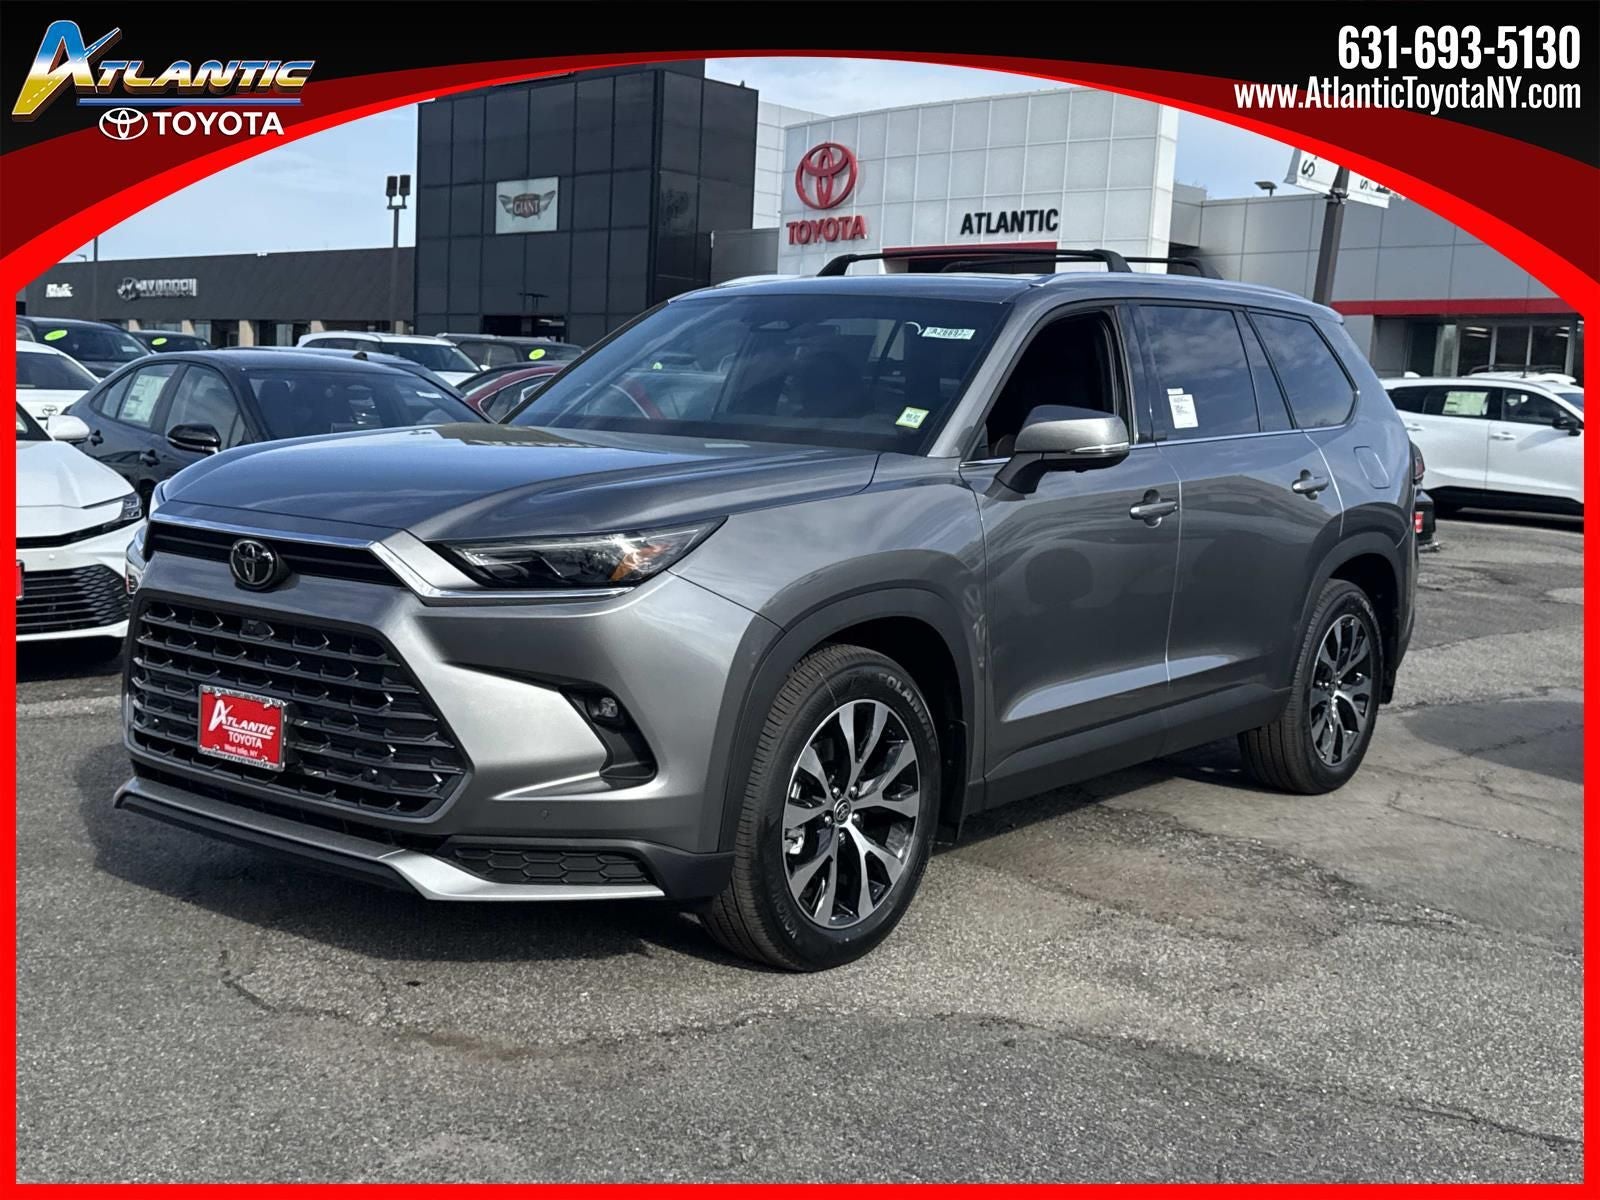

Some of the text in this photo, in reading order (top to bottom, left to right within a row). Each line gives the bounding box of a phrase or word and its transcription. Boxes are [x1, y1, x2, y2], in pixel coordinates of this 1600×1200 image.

[786, 215, 866, 245] TOYOTA
[960, 208, 1059, 235] ATLANTIC
[208, 700, 276, 736] ATLANTIC
[228, 731, 263, 749] TOYOTA
